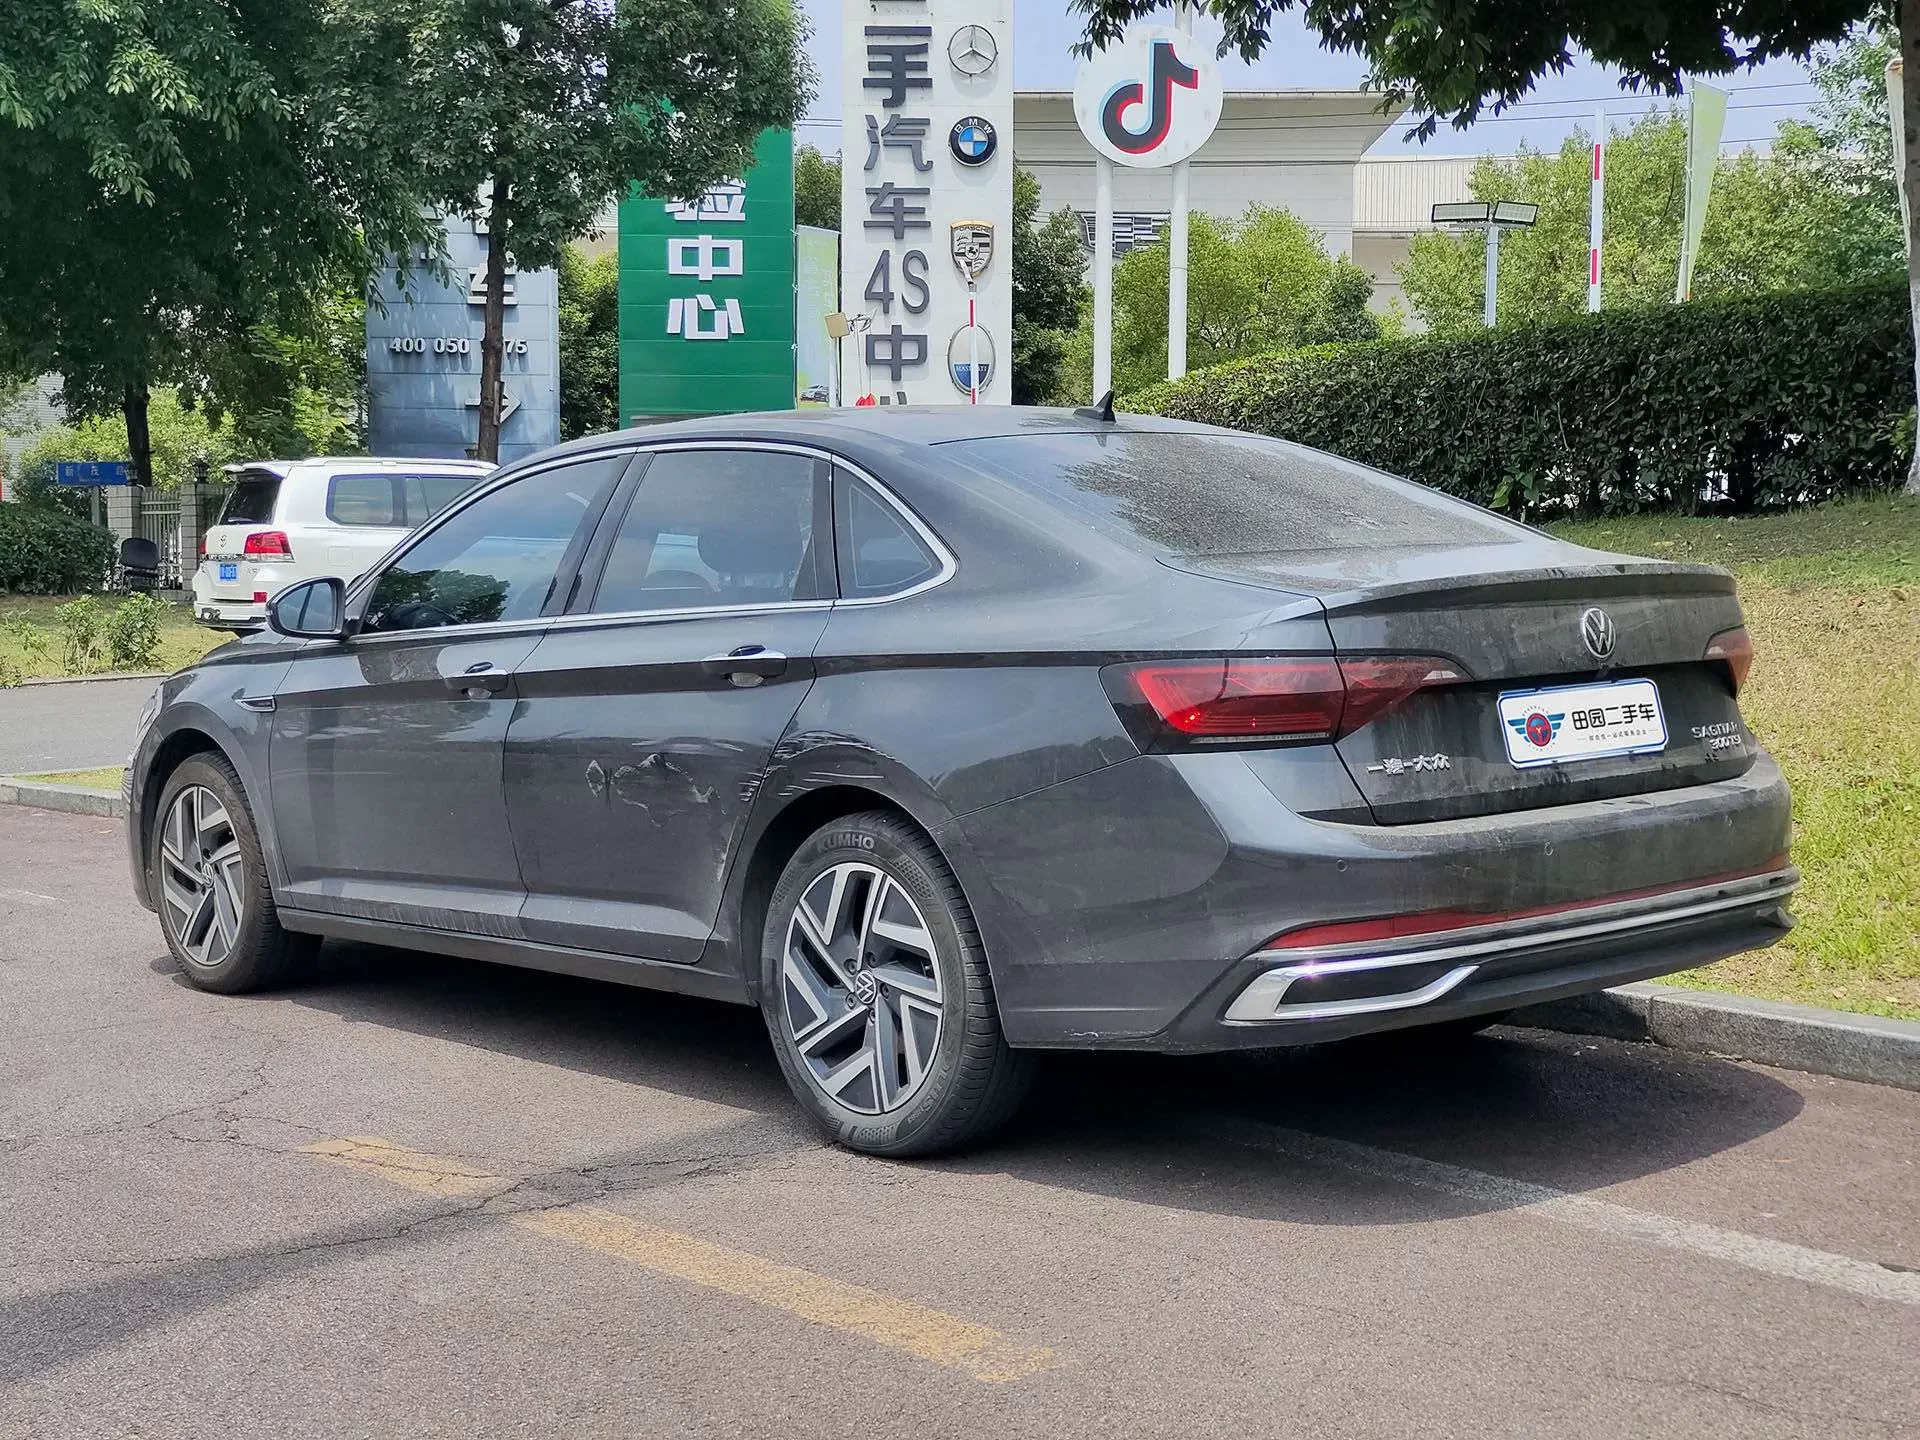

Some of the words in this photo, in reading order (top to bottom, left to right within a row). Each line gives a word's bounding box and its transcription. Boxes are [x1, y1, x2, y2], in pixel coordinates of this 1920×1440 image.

[954, 118, 993, 134] BMW
[390, 337, 426, 354] 400
[433, 337, 470, 354] 050
[1571, 703, 1656, 731] 田园二手车
[817, 832, 875, 854] KUMHO
